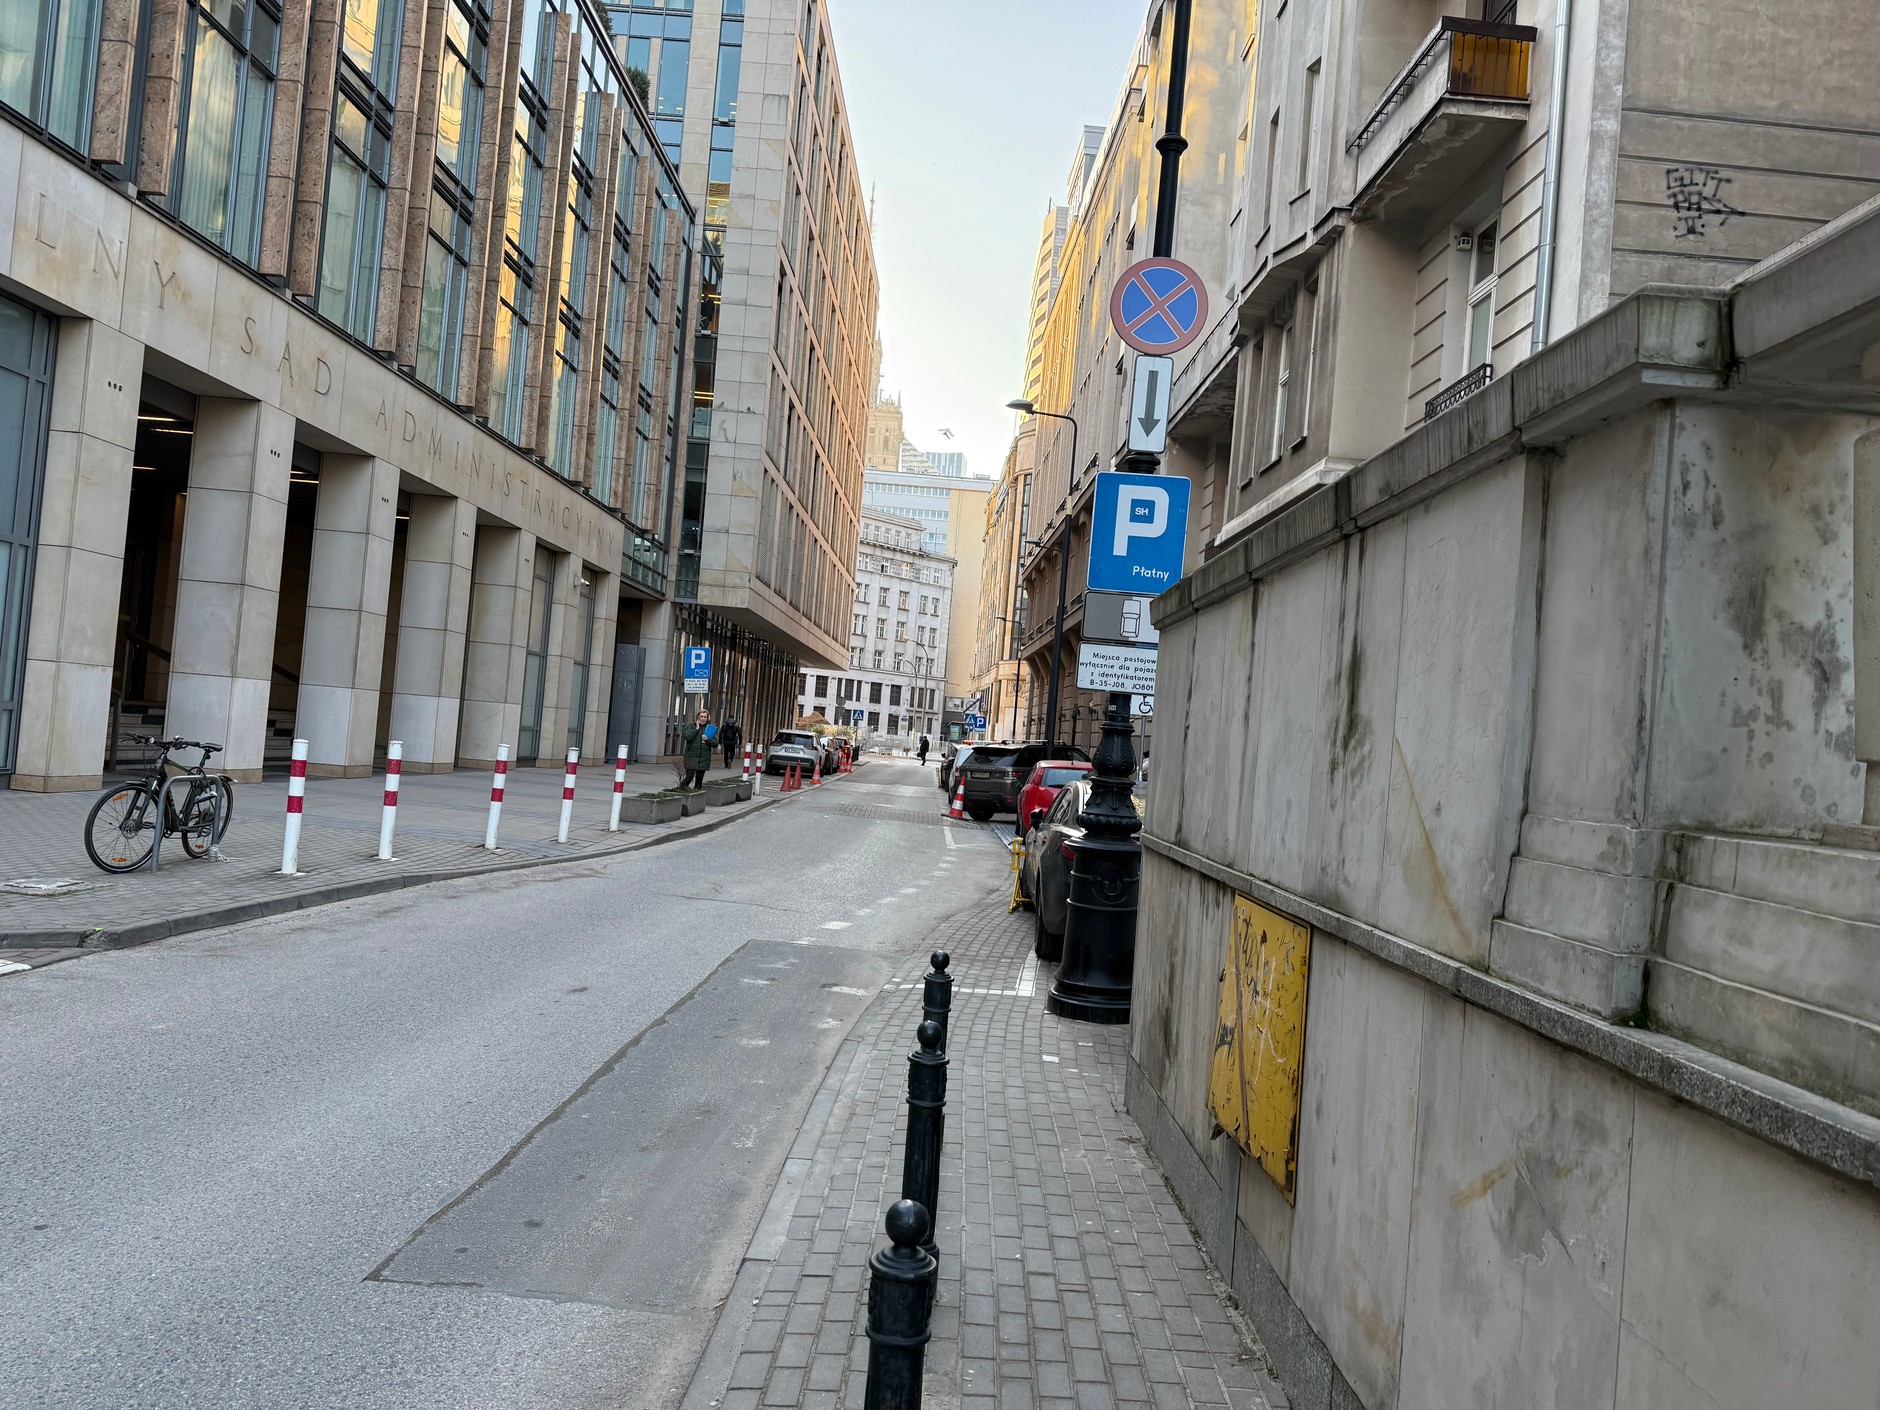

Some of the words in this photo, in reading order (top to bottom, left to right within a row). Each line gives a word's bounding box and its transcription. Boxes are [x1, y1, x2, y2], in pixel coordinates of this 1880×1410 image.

[240, 316, 332, 396] SĄD
[1113, 484, 1169, 556] P
[1132, 565, 1169, 582] Płatny
[691, 650, 706, 669] P
[1092, 652, 1120, 661] Miejsca
[1079, 661, 1115, 670] wyłącznie
[1098, 670, 1155, 682] identyfikatorem
[976, 717, 984, 727] P
